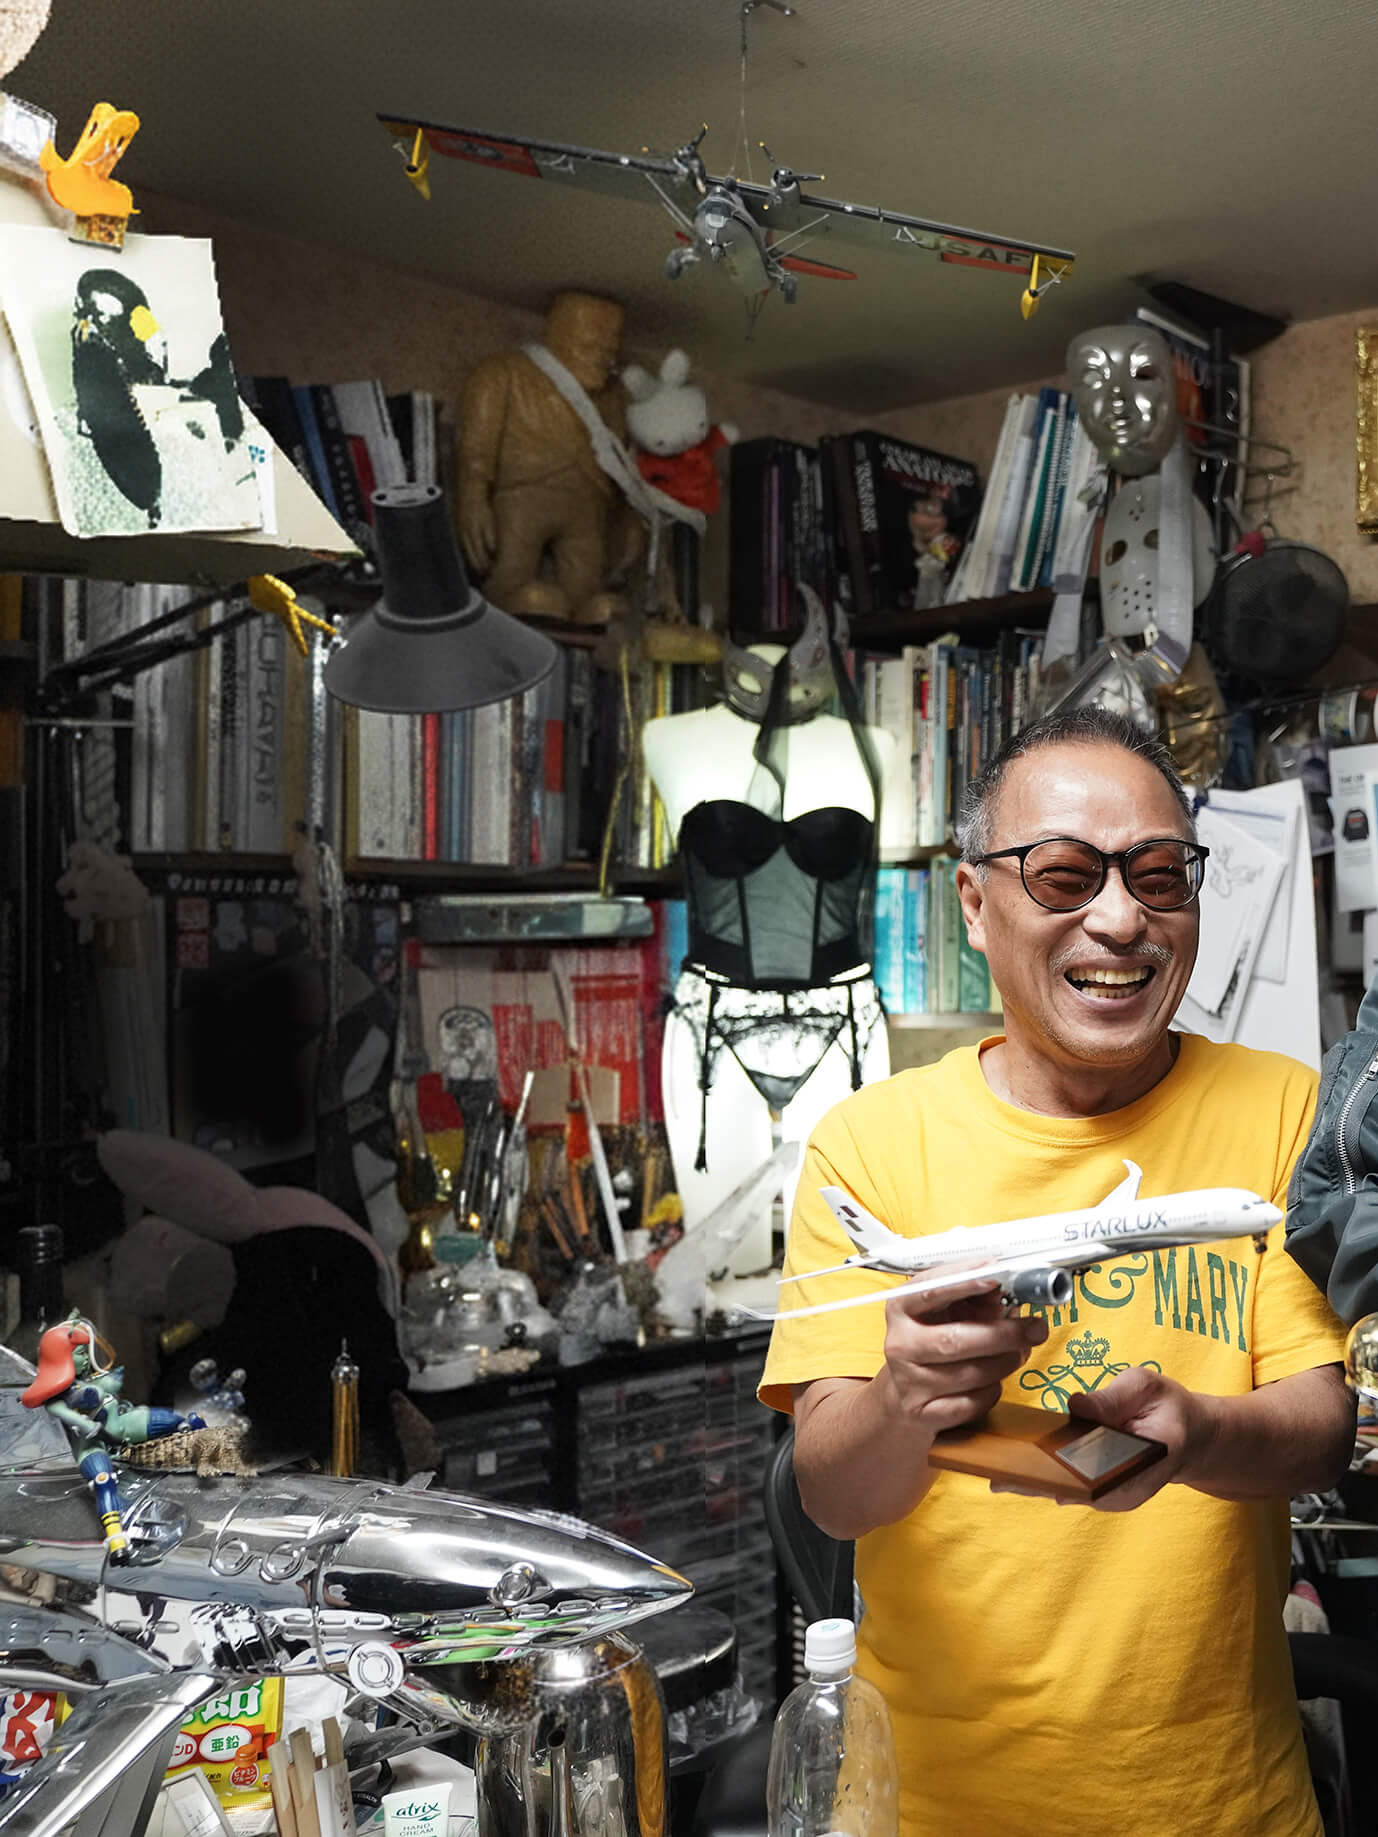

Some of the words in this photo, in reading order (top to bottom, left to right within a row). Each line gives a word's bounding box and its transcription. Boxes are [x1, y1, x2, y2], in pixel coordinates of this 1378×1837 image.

[1063, 1209, 1168, 1243] STARLUX
[1152, 1246, 1248, 1353] MARY
[211, 1735, 240, 1753] 亜鉛
[396, 1802, 439, 1817] atrix
[399, 1828, 434, 1837] CREAM
